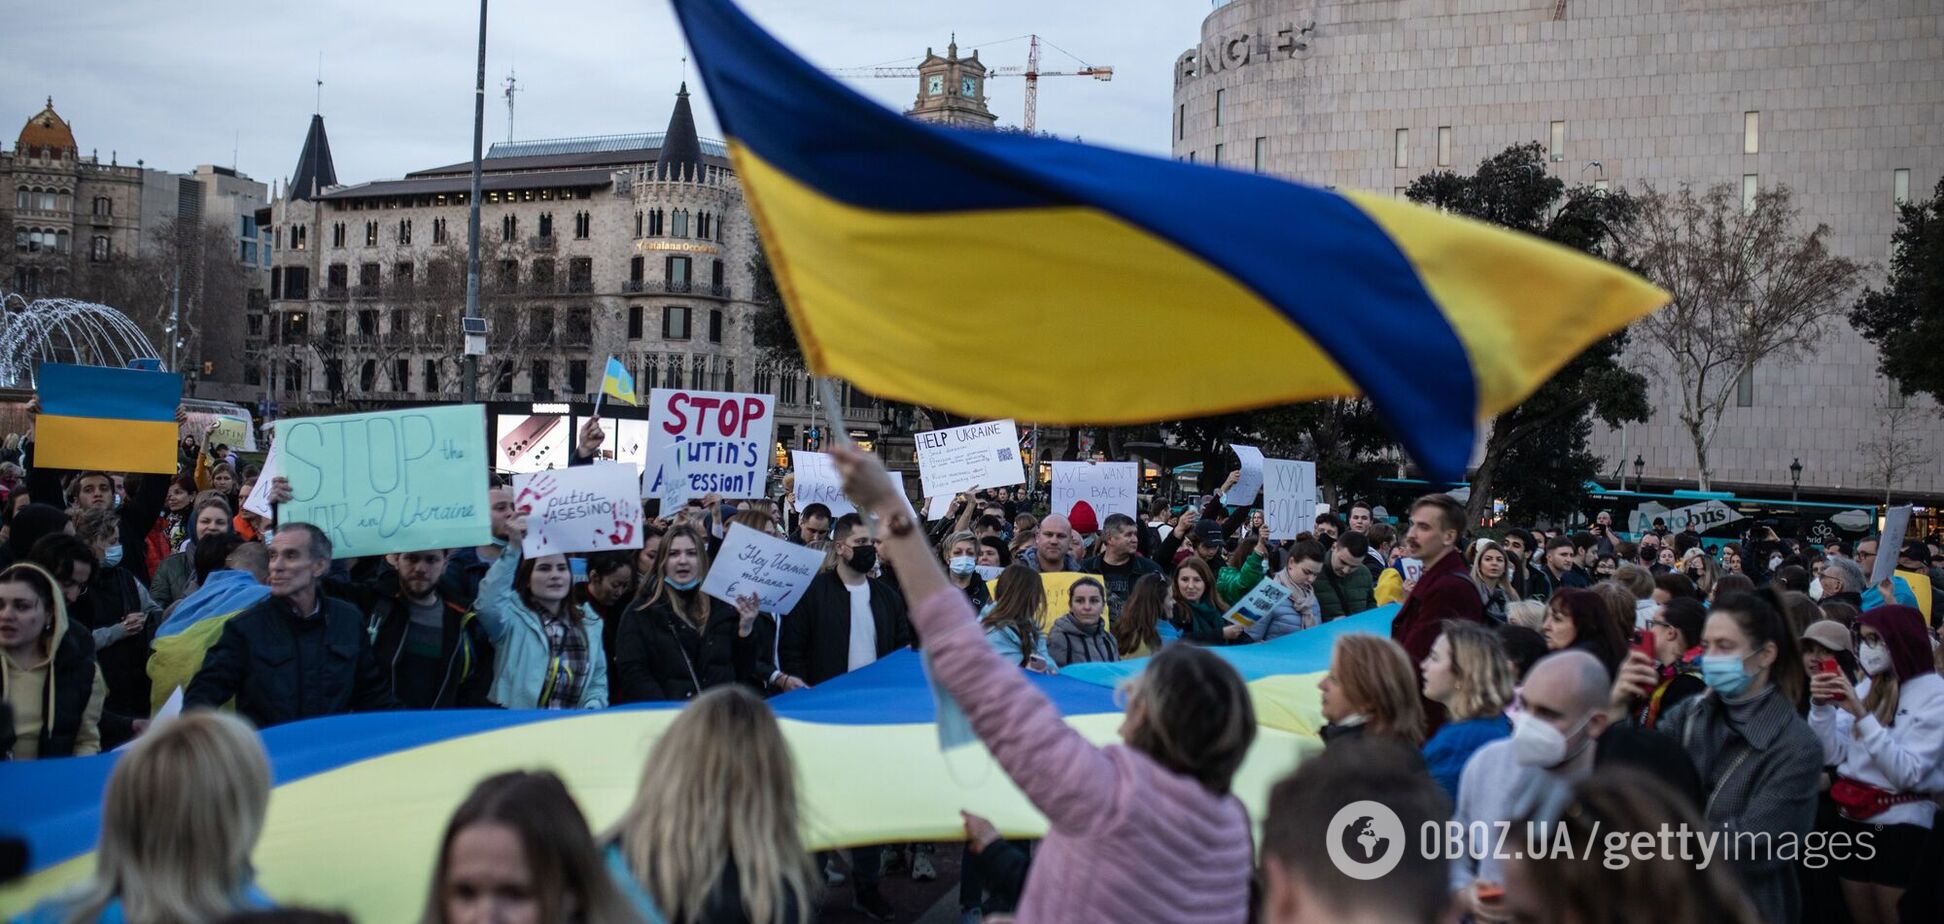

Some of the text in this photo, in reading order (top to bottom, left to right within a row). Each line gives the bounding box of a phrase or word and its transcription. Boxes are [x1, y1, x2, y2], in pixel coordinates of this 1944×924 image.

[663, 392, 765, 438] STOP
[916, 432, 948, 450] HELP
[955, 423, 1001, 442] UKRAINE
[286, 415, 435, 502] STOP
[440, 439, 464, 460] the
[1055, 465, 1135, 484] WE WANT
[1275, 463, 1304, 493] ХУЙ
[547, 489, 606, 517] putin
[1056, 486, 1129, 499] TO BACK
[364, 496, 476, 538] Ukraine
[739, 544, 767, 575] Hoy
